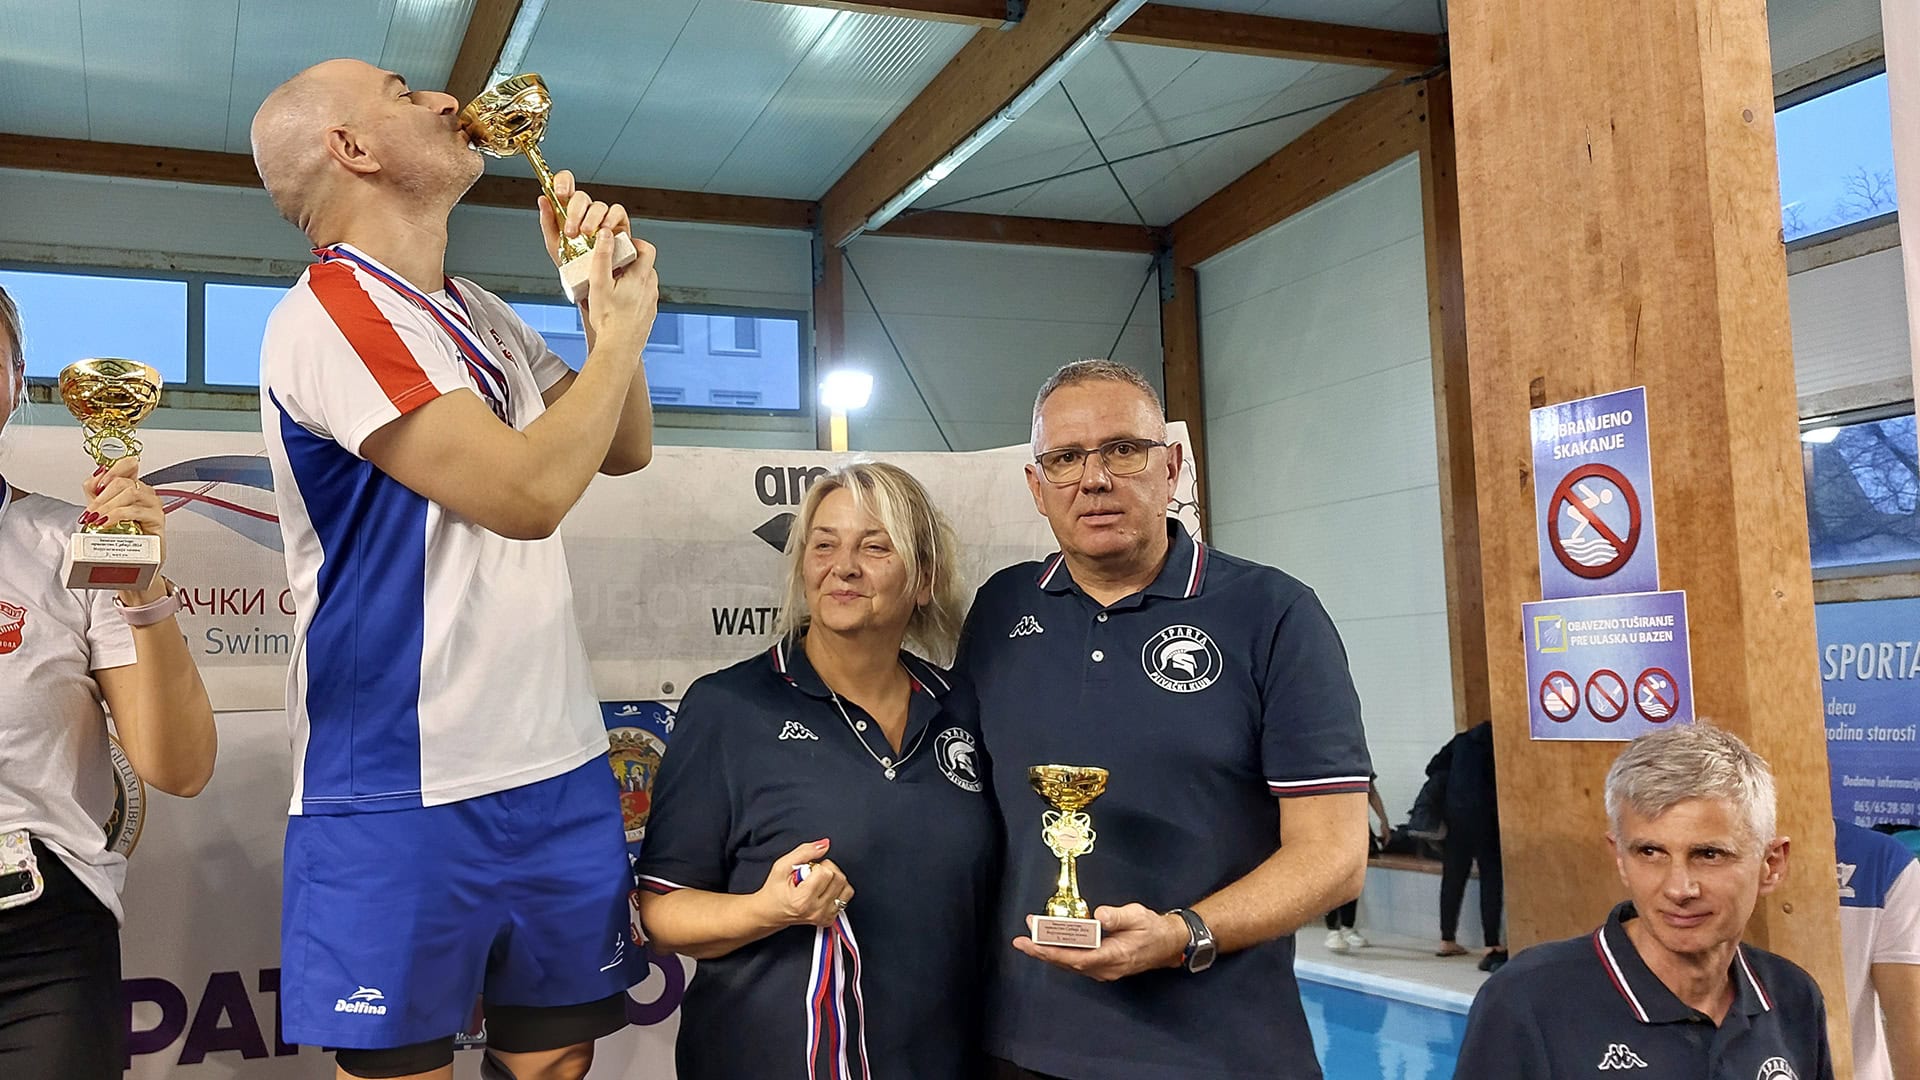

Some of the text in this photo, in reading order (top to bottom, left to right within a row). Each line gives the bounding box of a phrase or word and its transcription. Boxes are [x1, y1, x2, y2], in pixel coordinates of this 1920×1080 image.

[1545, 410, 1633, 439] BRANJENO
[1553, 434, 1625, 460] SKAKANJE
[179, 587, 265, 616] АЧКИ
[1567, 615, 1674, 632] OBAVEZNO TUŠIRANJE
[205, 627, 289, 655] Swim
[1161, 628, 1208, 646] SPARTA
[1570, 630, 1673, 646] PRE ULASKA U BAZEN
[1189, 677, 1212, 691] KLUB
[1828, 697, 1857, 716] decu
[1825, 721, 1916, 742] odina starosti
[109, 741, 138, 793] GILLUM
[335, 999, 387, 1016] Delfina
